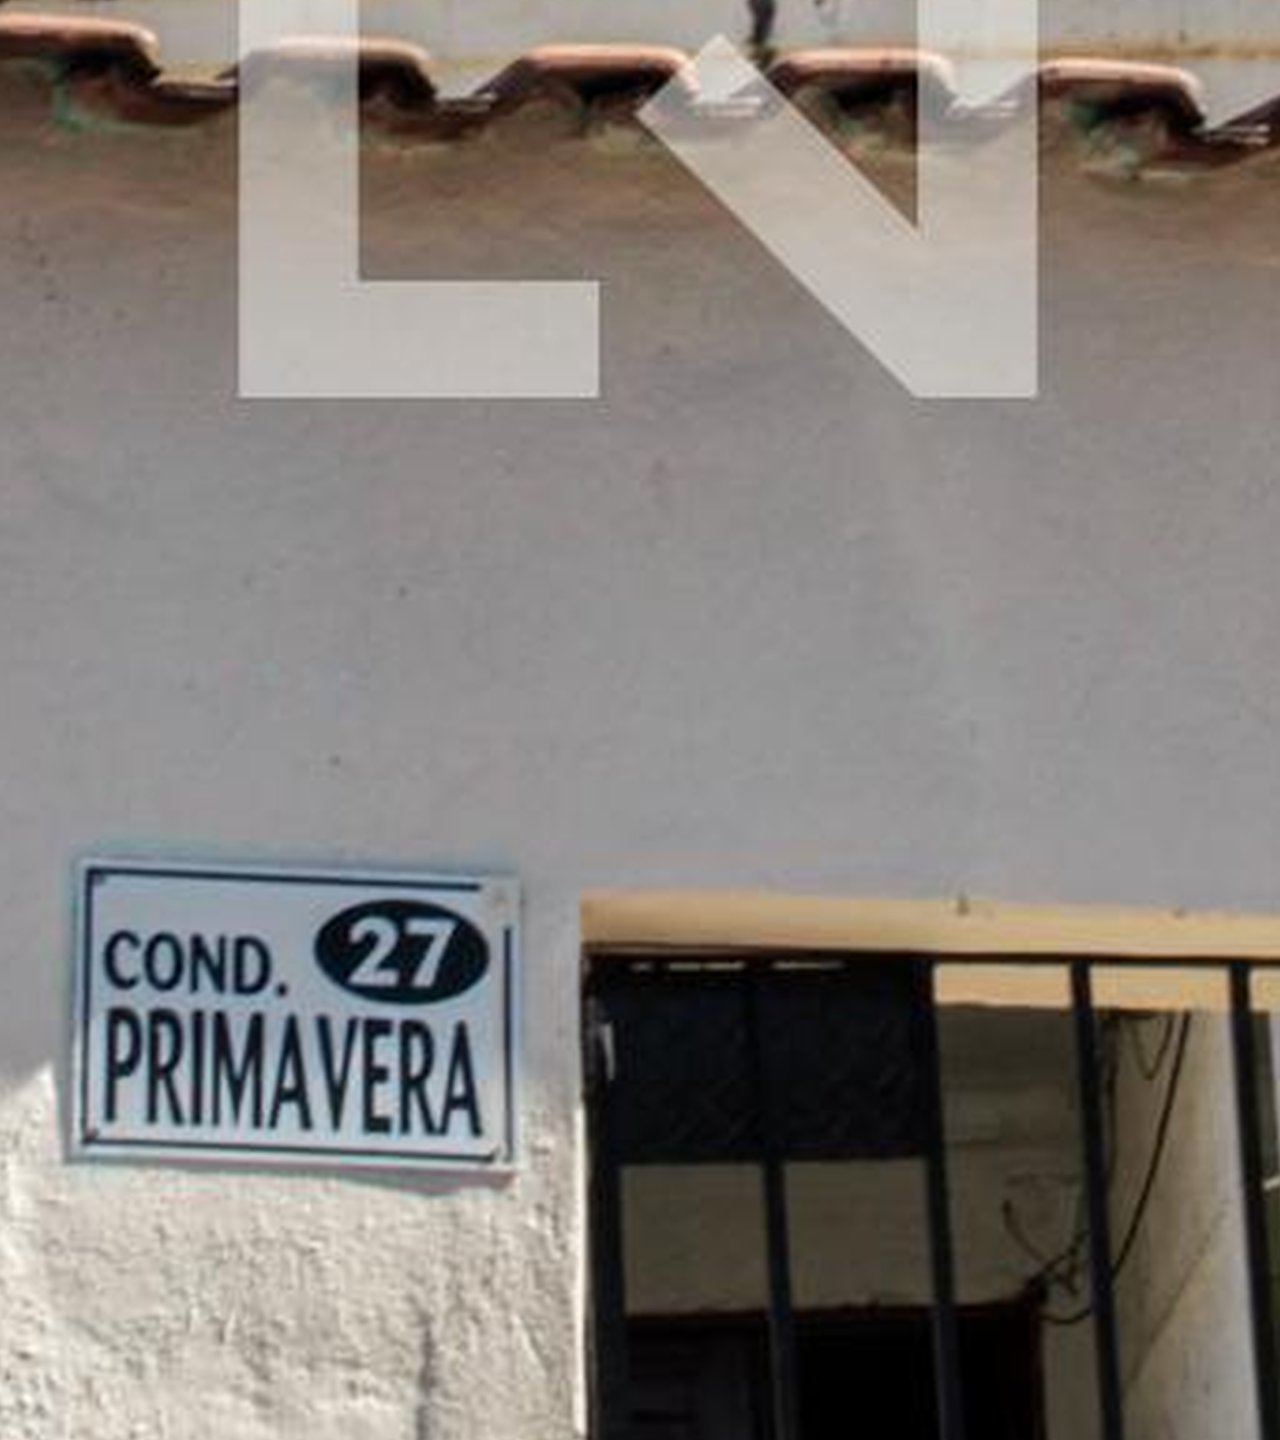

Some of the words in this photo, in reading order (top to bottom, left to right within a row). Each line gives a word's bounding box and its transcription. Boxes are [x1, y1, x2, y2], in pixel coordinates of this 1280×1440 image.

[103, 930, 287, 997] COND.
[348, 916, 458, 988] 27
[105, 1008, 483, 1136] PRIMAVERA
